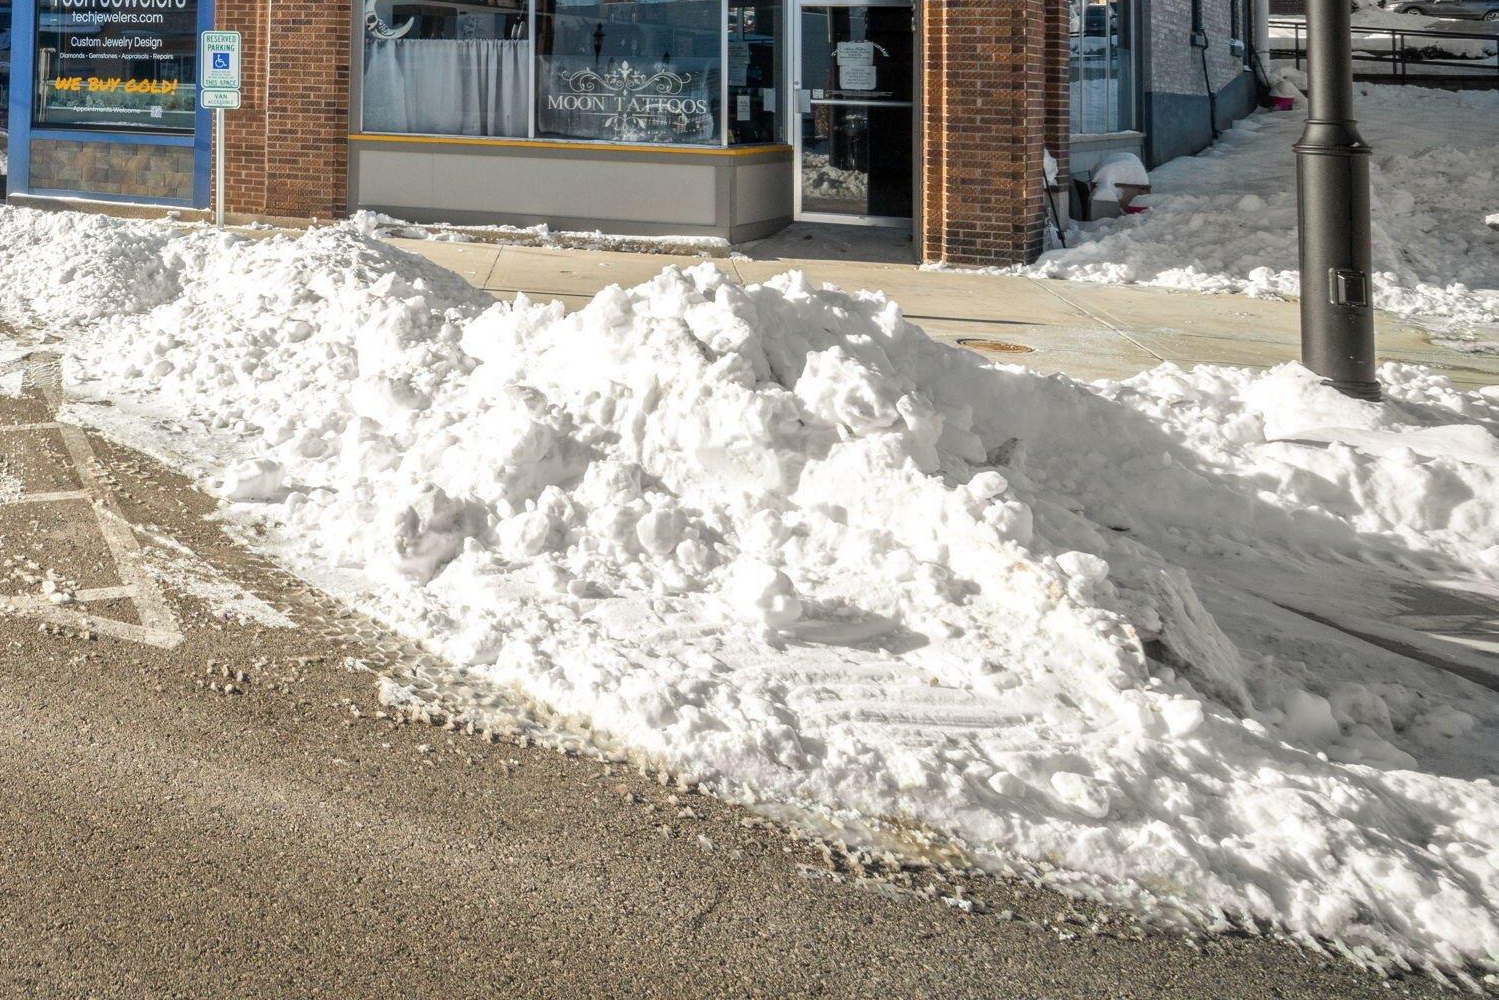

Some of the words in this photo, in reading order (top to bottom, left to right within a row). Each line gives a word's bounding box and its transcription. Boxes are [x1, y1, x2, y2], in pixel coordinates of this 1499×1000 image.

[71, 11, 164, 25] techjewelers.com
[70, 36, 101, 47] Custom
[102, 36, 133, 49] Jewelry
[134, 36, 163, 50] Design
[207, 44, 235, 52] PARKING
[54, 75, 82, 91] WE
[87, 77, 121, 93] BUY
[124, 77, 178, 96] GOLD!
[547, 95, 606, 111] MOON
[613, 97, 707, 115] TATTOOS
